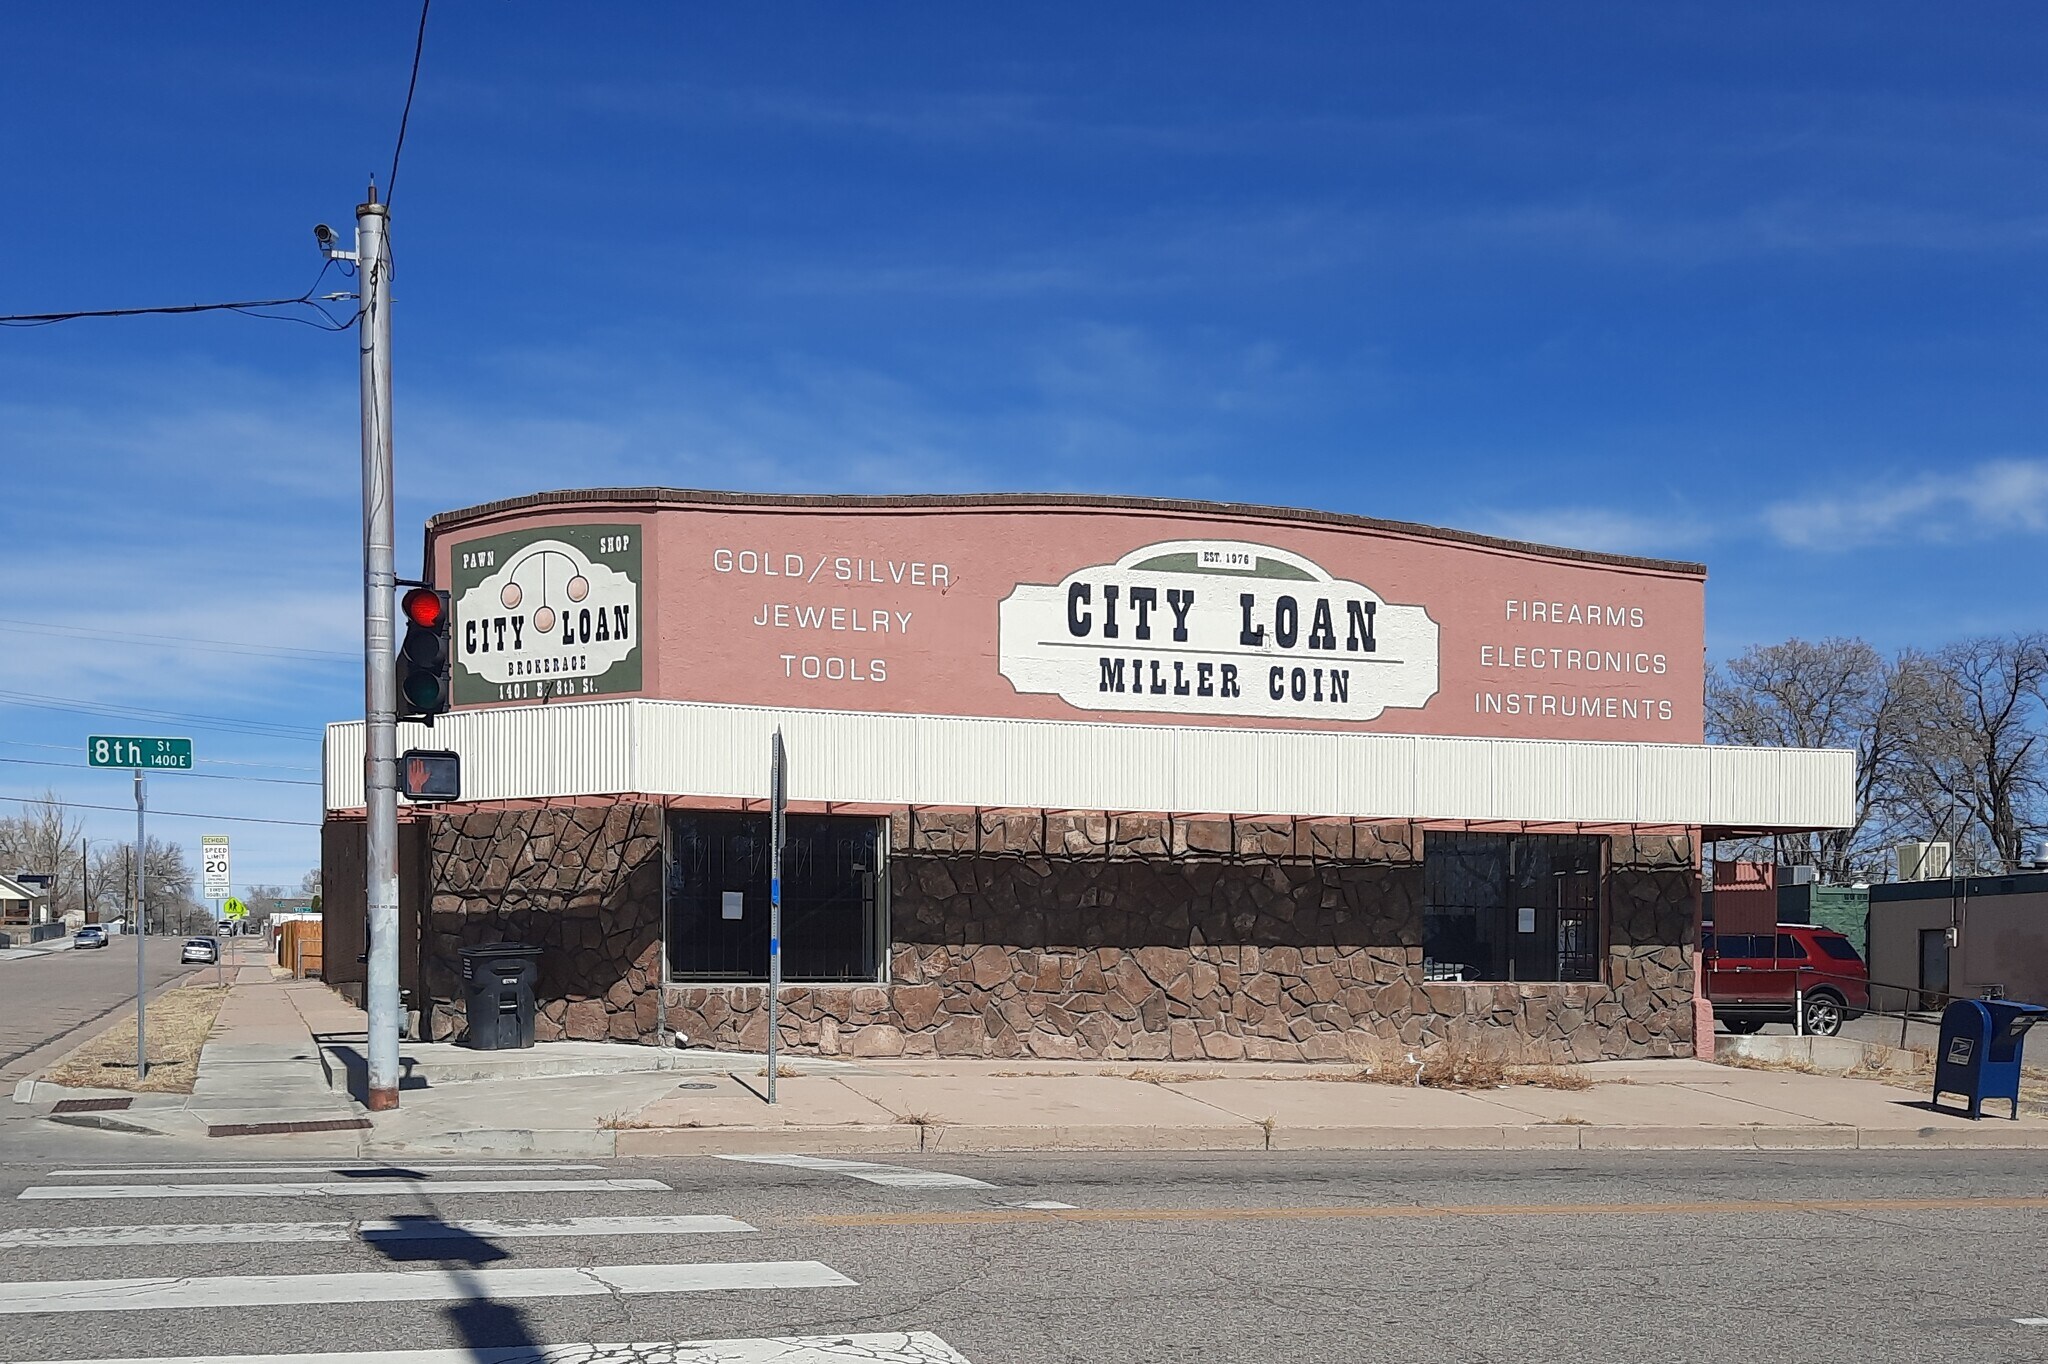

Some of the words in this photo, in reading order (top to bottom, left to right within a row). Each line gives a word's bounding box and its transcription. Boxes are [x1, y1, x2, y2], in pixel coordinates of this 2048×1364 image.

[463, 551, 494, 569] PAWN
[600, 535, 630, 553] SHOP
[1203, 551, 1221, 563] EST.
[1226, 553, 1249, 565] 1976
[713, 549, 950, 587] GOLD/SILVER
[753, 603, 913, 634] JEWELRY
[1067, 581, 1194, 642] CITY
[1239, 593, 1376, 652] LOAN
[1505, 600, 1644, 628] FIREARMS
[466, 615, 524, 654] CITY
[562, 605, 629, 645] LOAN
[508, 655, 586, 676] BROKERAGE
[780, 654, 887, 682] TOOLS
[1480, 645, 1667, 674] ELECTRONICS
[499, 682, 527, 700] 1401
[556, 679, 574, 695] 8th
[582, 678, 598, 693] St.
[1099, 657, 1240, 698] MILLER
[1269, 665, 1349, 703] COIN
[1474, 692, 1673, 720] INSTRUMENTS
[95, 739, 142, 764] 8th
[150, 754, 177, 766] 1400
[157, 740, 170, 752] St
[205, 861, 227, 873] 20
